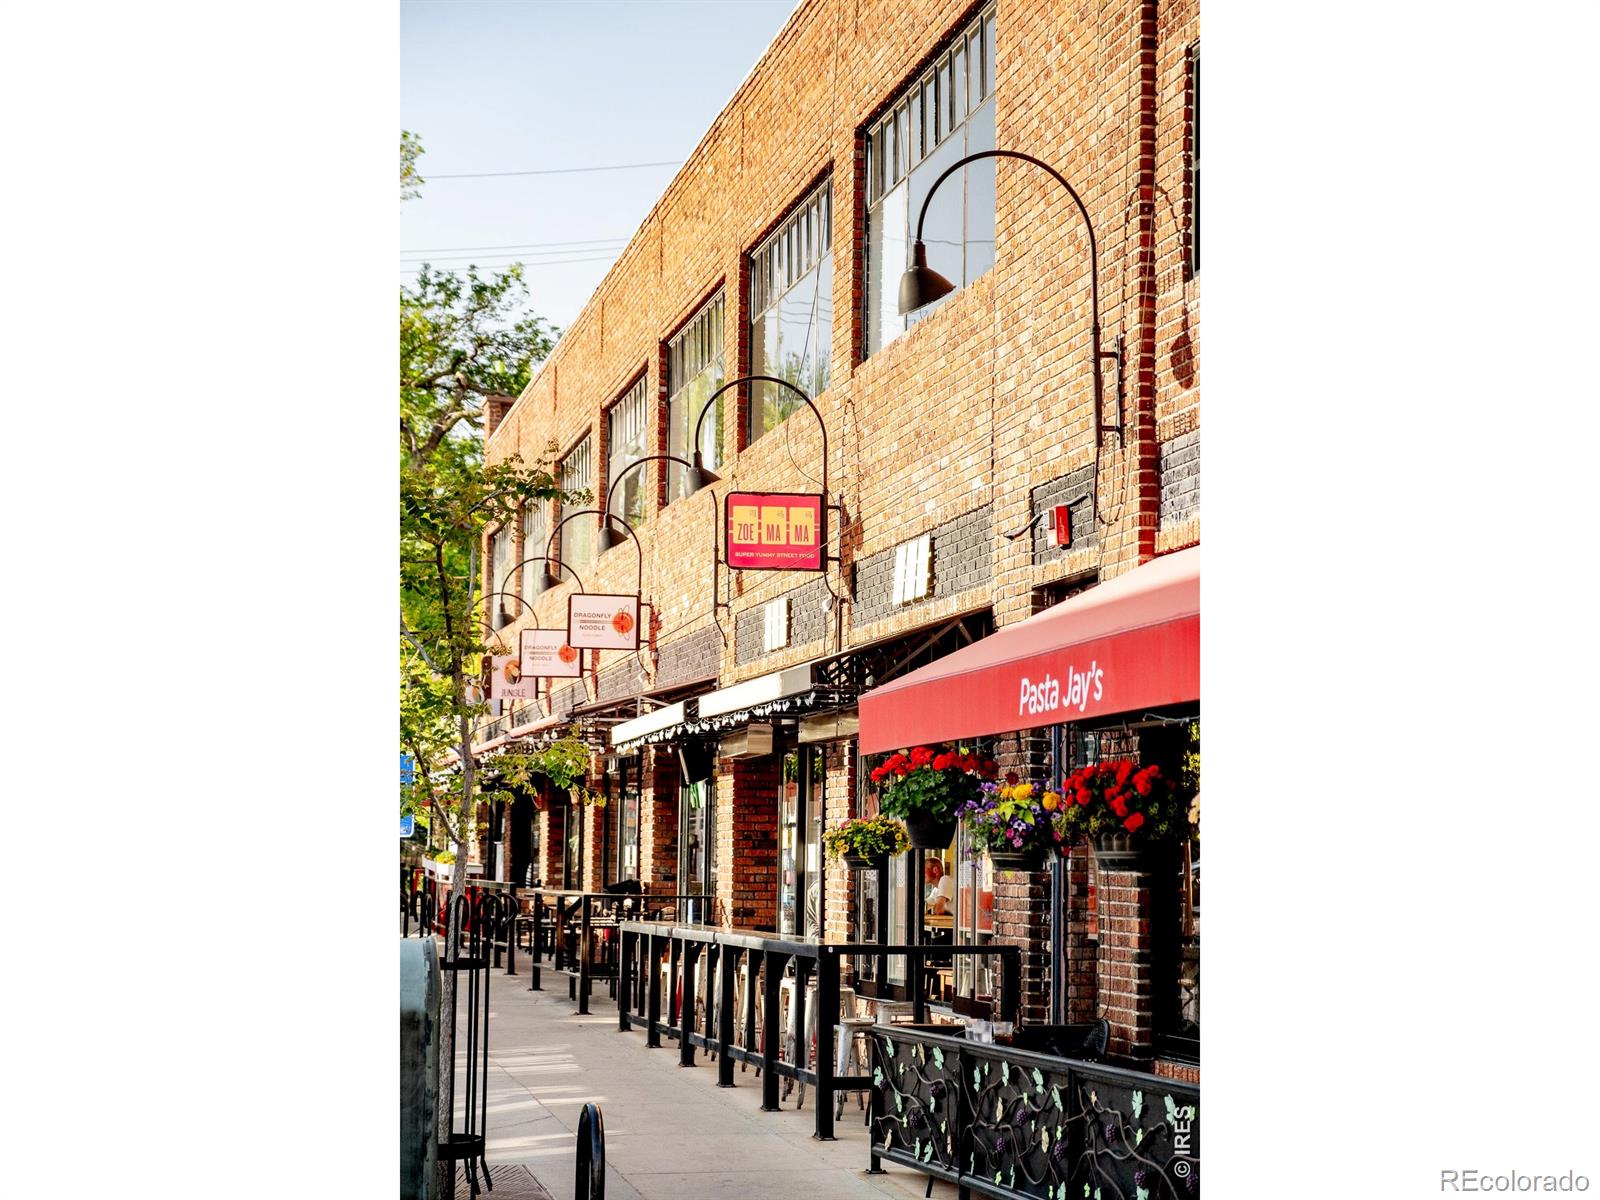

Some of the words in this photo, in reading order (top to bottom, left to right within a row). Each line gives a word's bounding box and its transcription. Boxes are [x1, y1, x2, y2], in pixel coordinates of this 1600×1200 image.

[737, 523, 755, 541] ZOE
[766, 524, 781, 542] MA
[794, 524, 810, 542] MA
[1019, 673, 1060, 716] Pasta
[1062, 660, 1104, 712] Jay's
